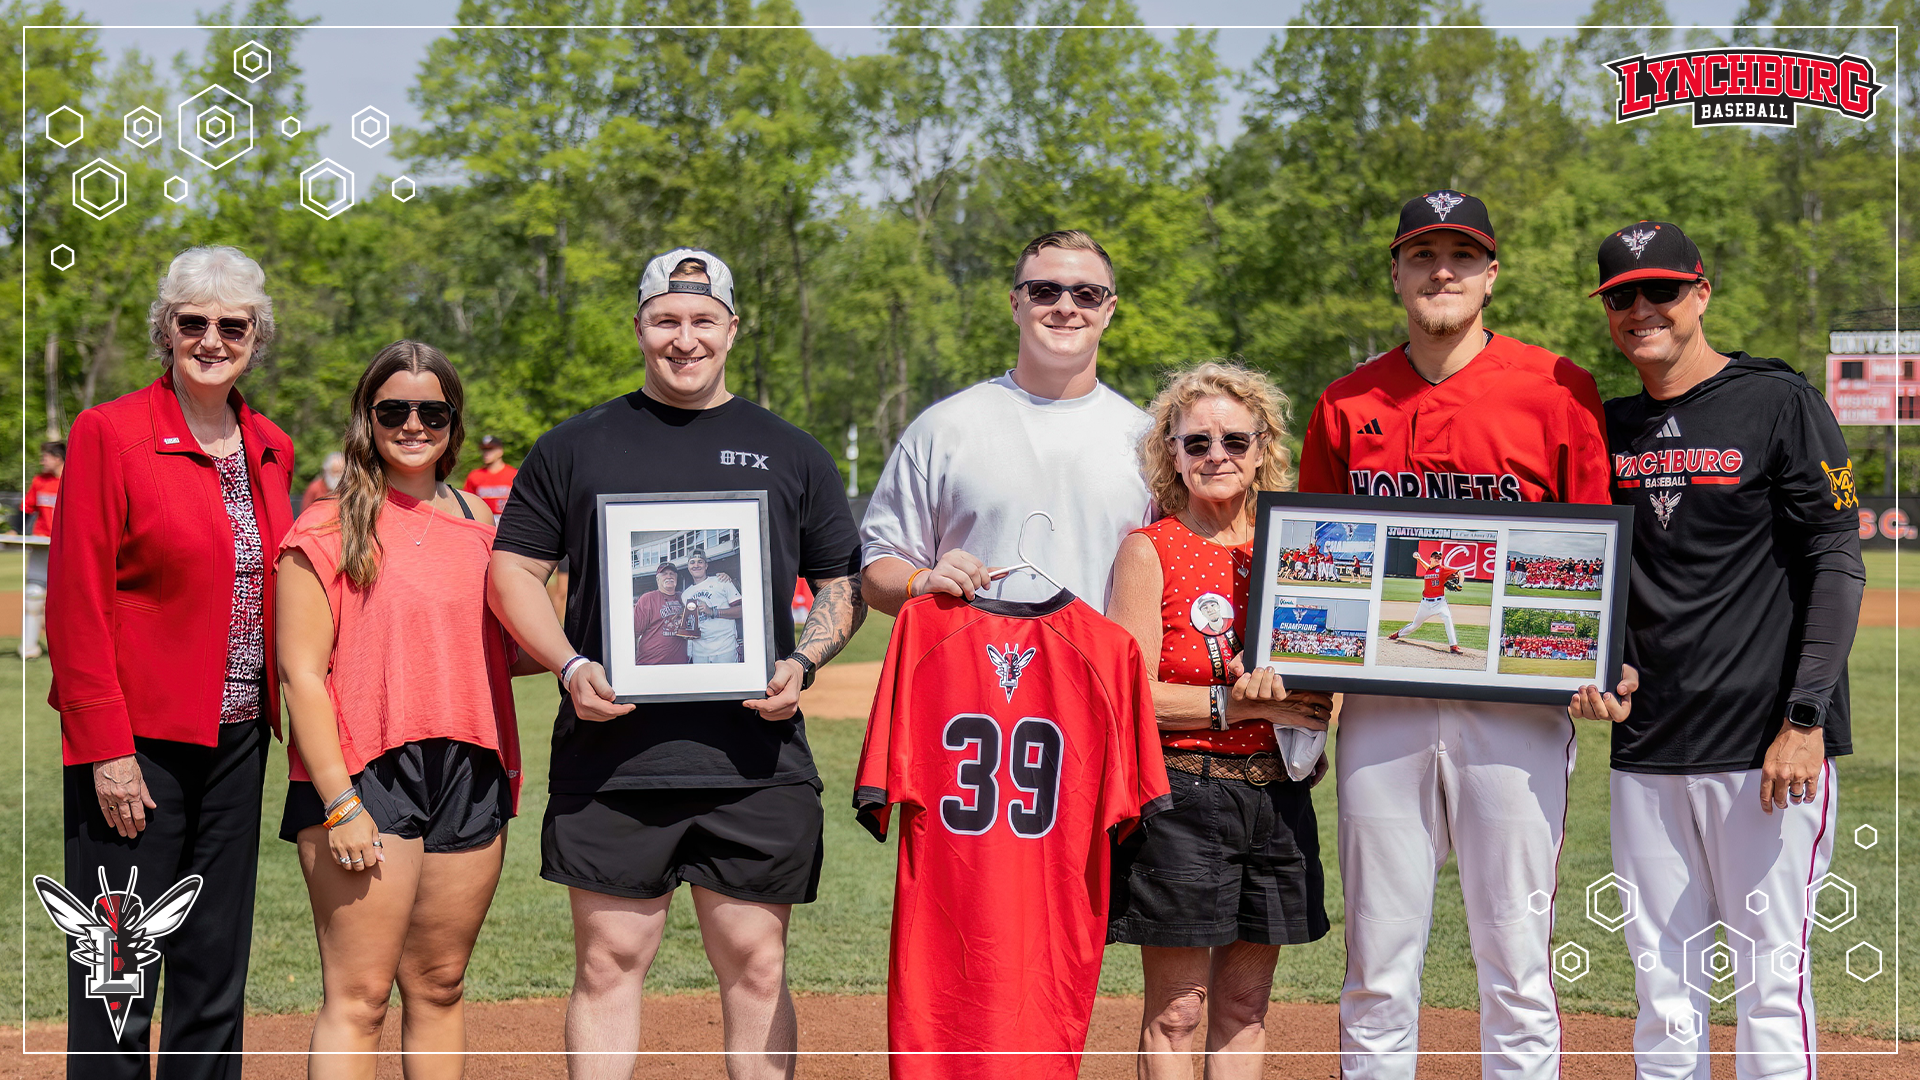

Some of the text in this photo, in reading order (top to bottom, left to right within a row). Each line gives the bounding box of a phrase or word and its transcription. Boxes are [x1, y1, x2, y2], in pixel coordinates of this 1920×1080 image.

[1612, 448, 1743, 478] YNCHBURG
[1645, 476, 1687, 489] BASEBALL
[1280, 622, 1317, 632] CHAMPIONS
[1207, 638, 1222, 678] SENIOR
[939, 713, 1065, 839] 39
